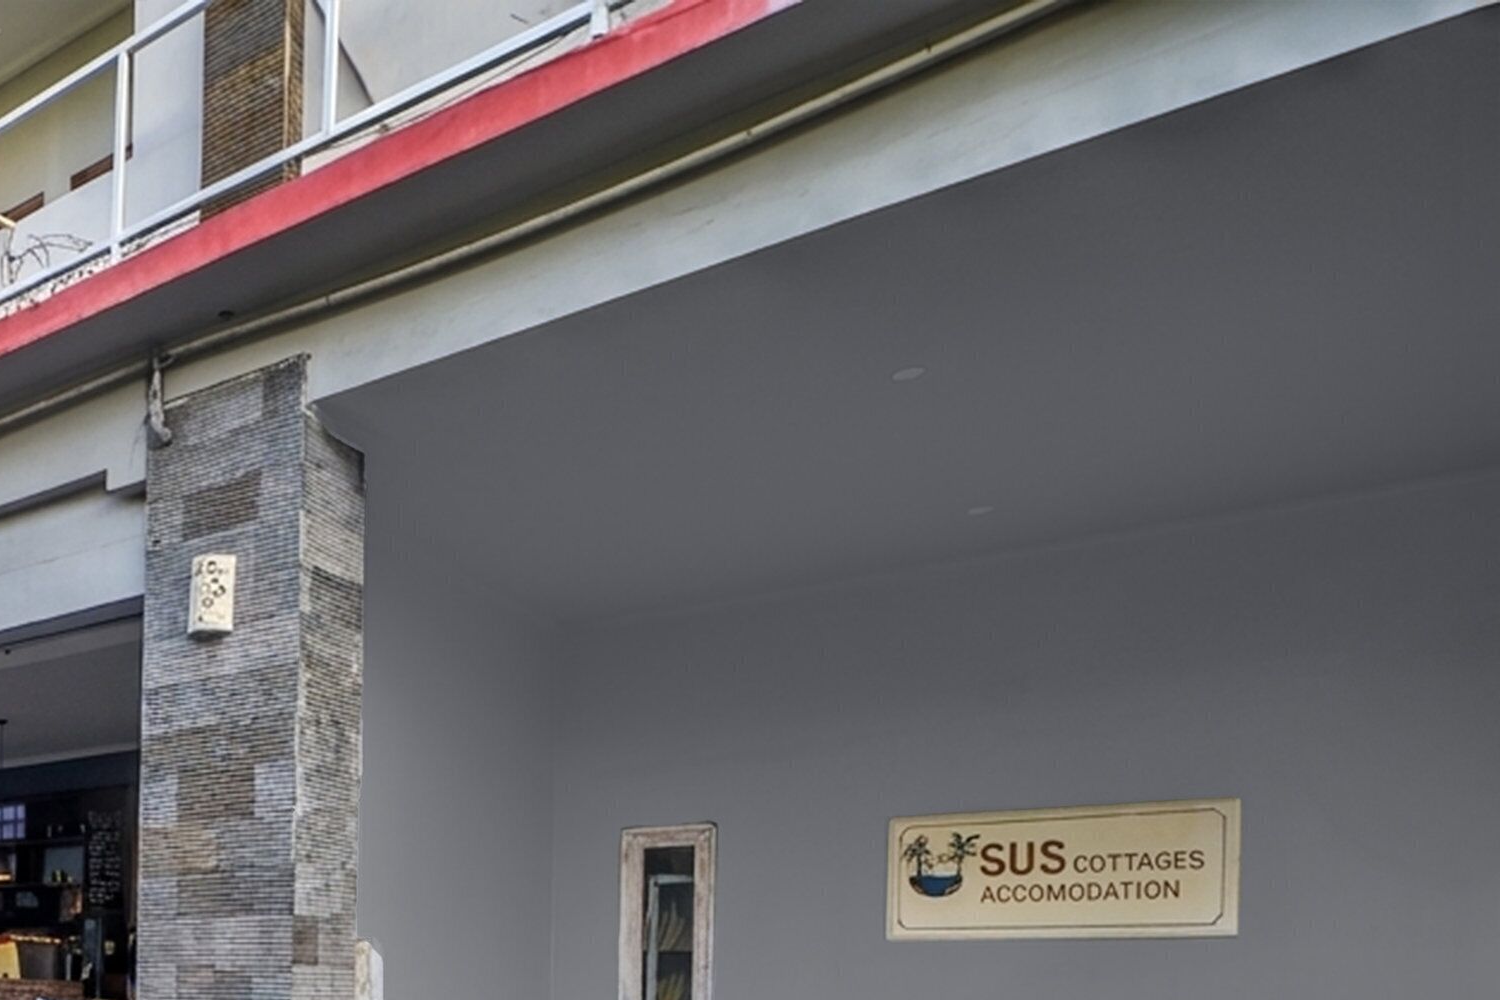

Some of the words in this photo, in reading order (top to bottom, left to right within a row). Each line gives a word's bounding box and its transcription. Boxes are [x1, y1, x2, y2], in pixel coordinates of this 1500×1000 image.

[980, 840, 1066, 876] SUS
[1073, 850, 1205, 873] COTTAGES
[980, 880, 1181, 903] ACCOMODATION
